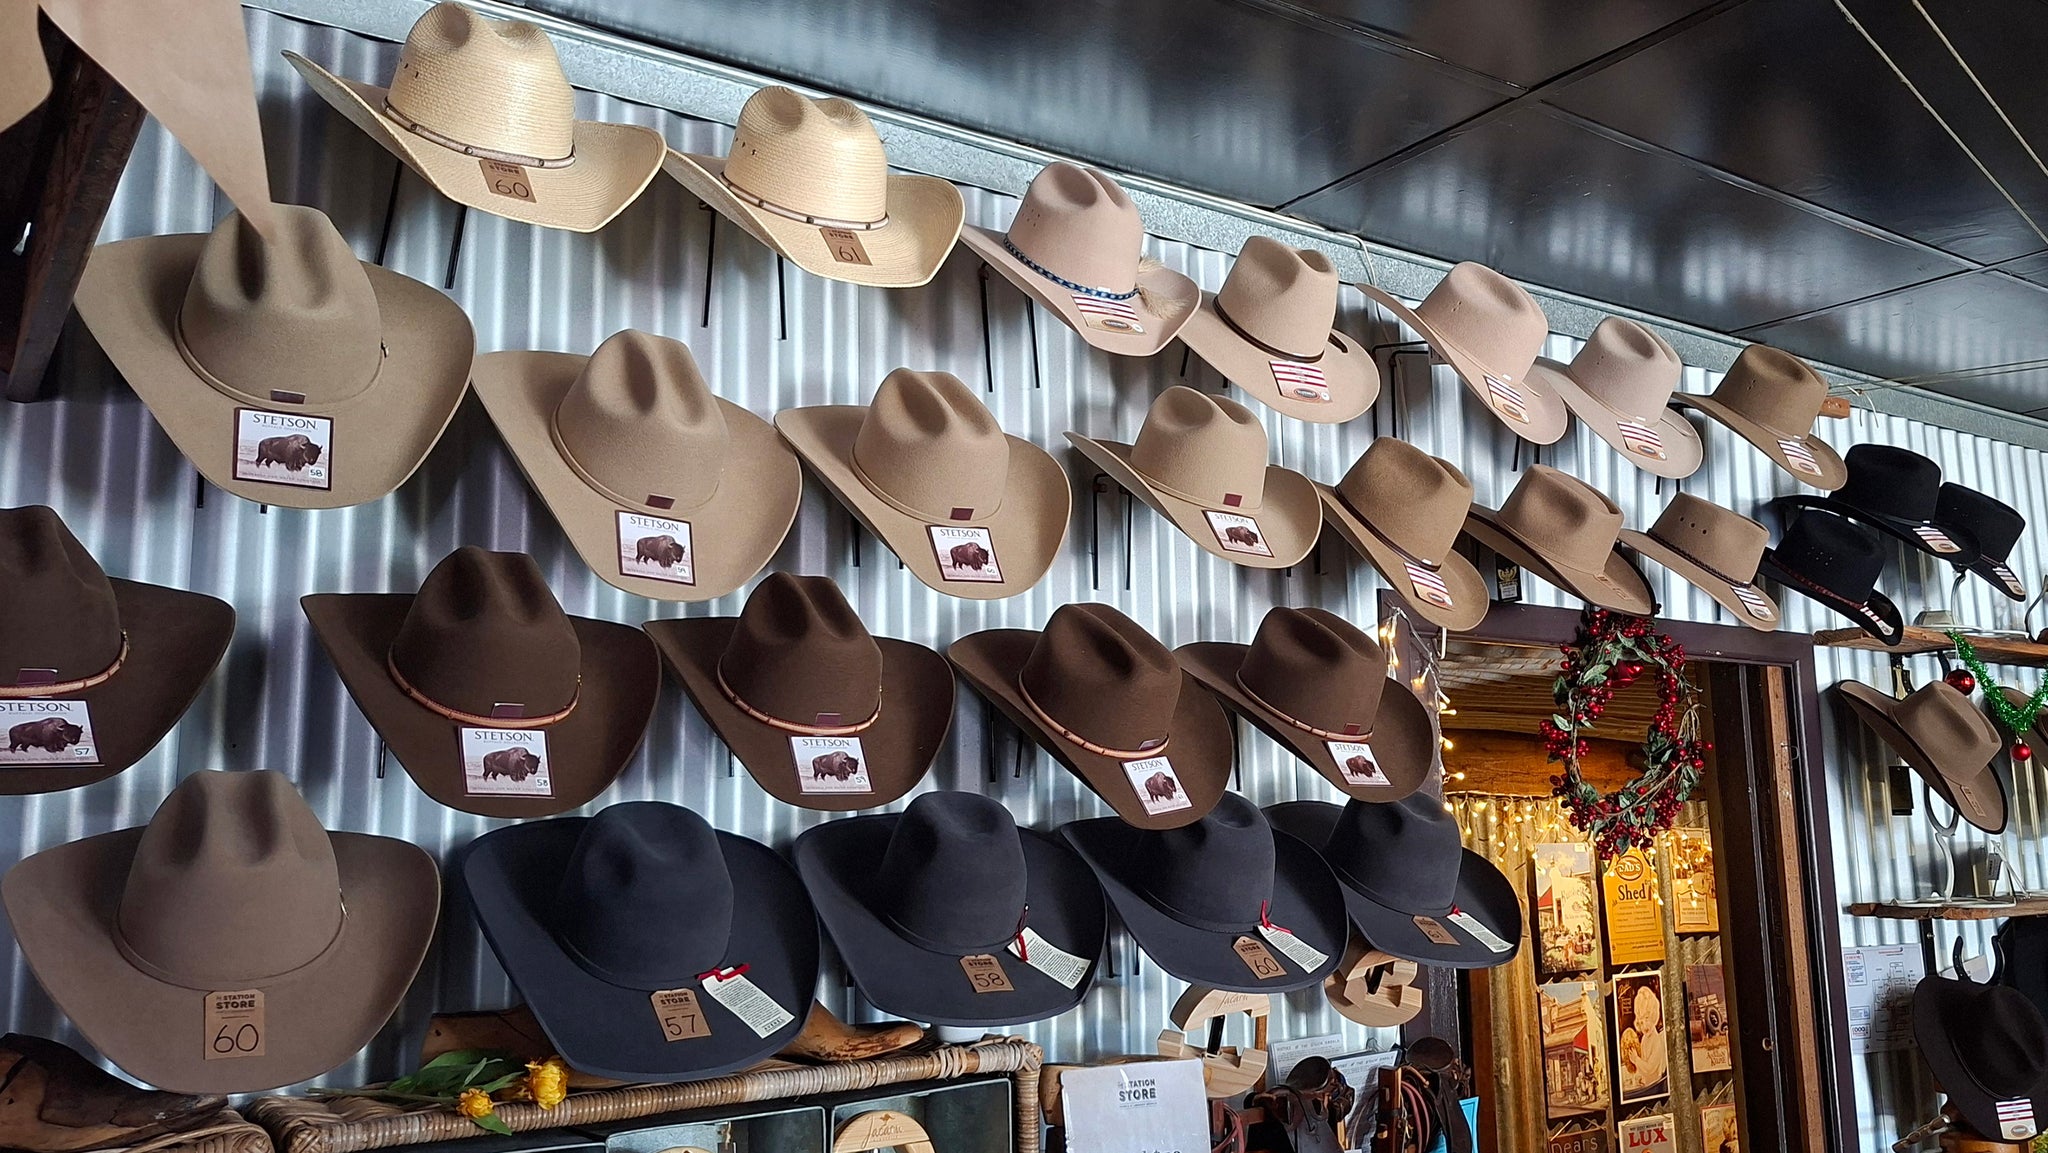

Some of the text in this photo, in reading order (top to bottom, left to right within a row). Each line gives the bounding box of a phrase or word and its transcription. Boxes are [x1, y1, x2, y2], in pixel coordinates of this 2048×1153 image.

[496, 180, 529, 198] 60
[839, 246, 860, 262] 61
[253, 413, 317, 429] STETSON
[310, 469, 323, 477] 58
[630, 515, 679, 531] STETSON
[940, 529, 981, 537] STETSON
[0, 703, 71, 712] STETSON
[474, 731, 533, 742] STETSON
[802, 739, 850, 747] STETSON
[1335, 744, 1366, 752] STETSON
[1131, 760, 1164, 771] STETSON
[1618, 883, 1646, 900] Shed
[1254, 957, 1279, 975] 60
[975, 972, 1004, 987] 58
[223, 993, 255, 1001] STATION
[661, 997, 690, 1005] STORE
[216, 1000, 255, 1009] STORE
[665, 1014, 695, 1036] 57
[213, 1024, 259, 1053] 60
[1125, 1079, 1155, 1089] TATION
[1119, 1088, 1156, 1101] STORE
[1629, 1127, 1667, 1147] LUX
